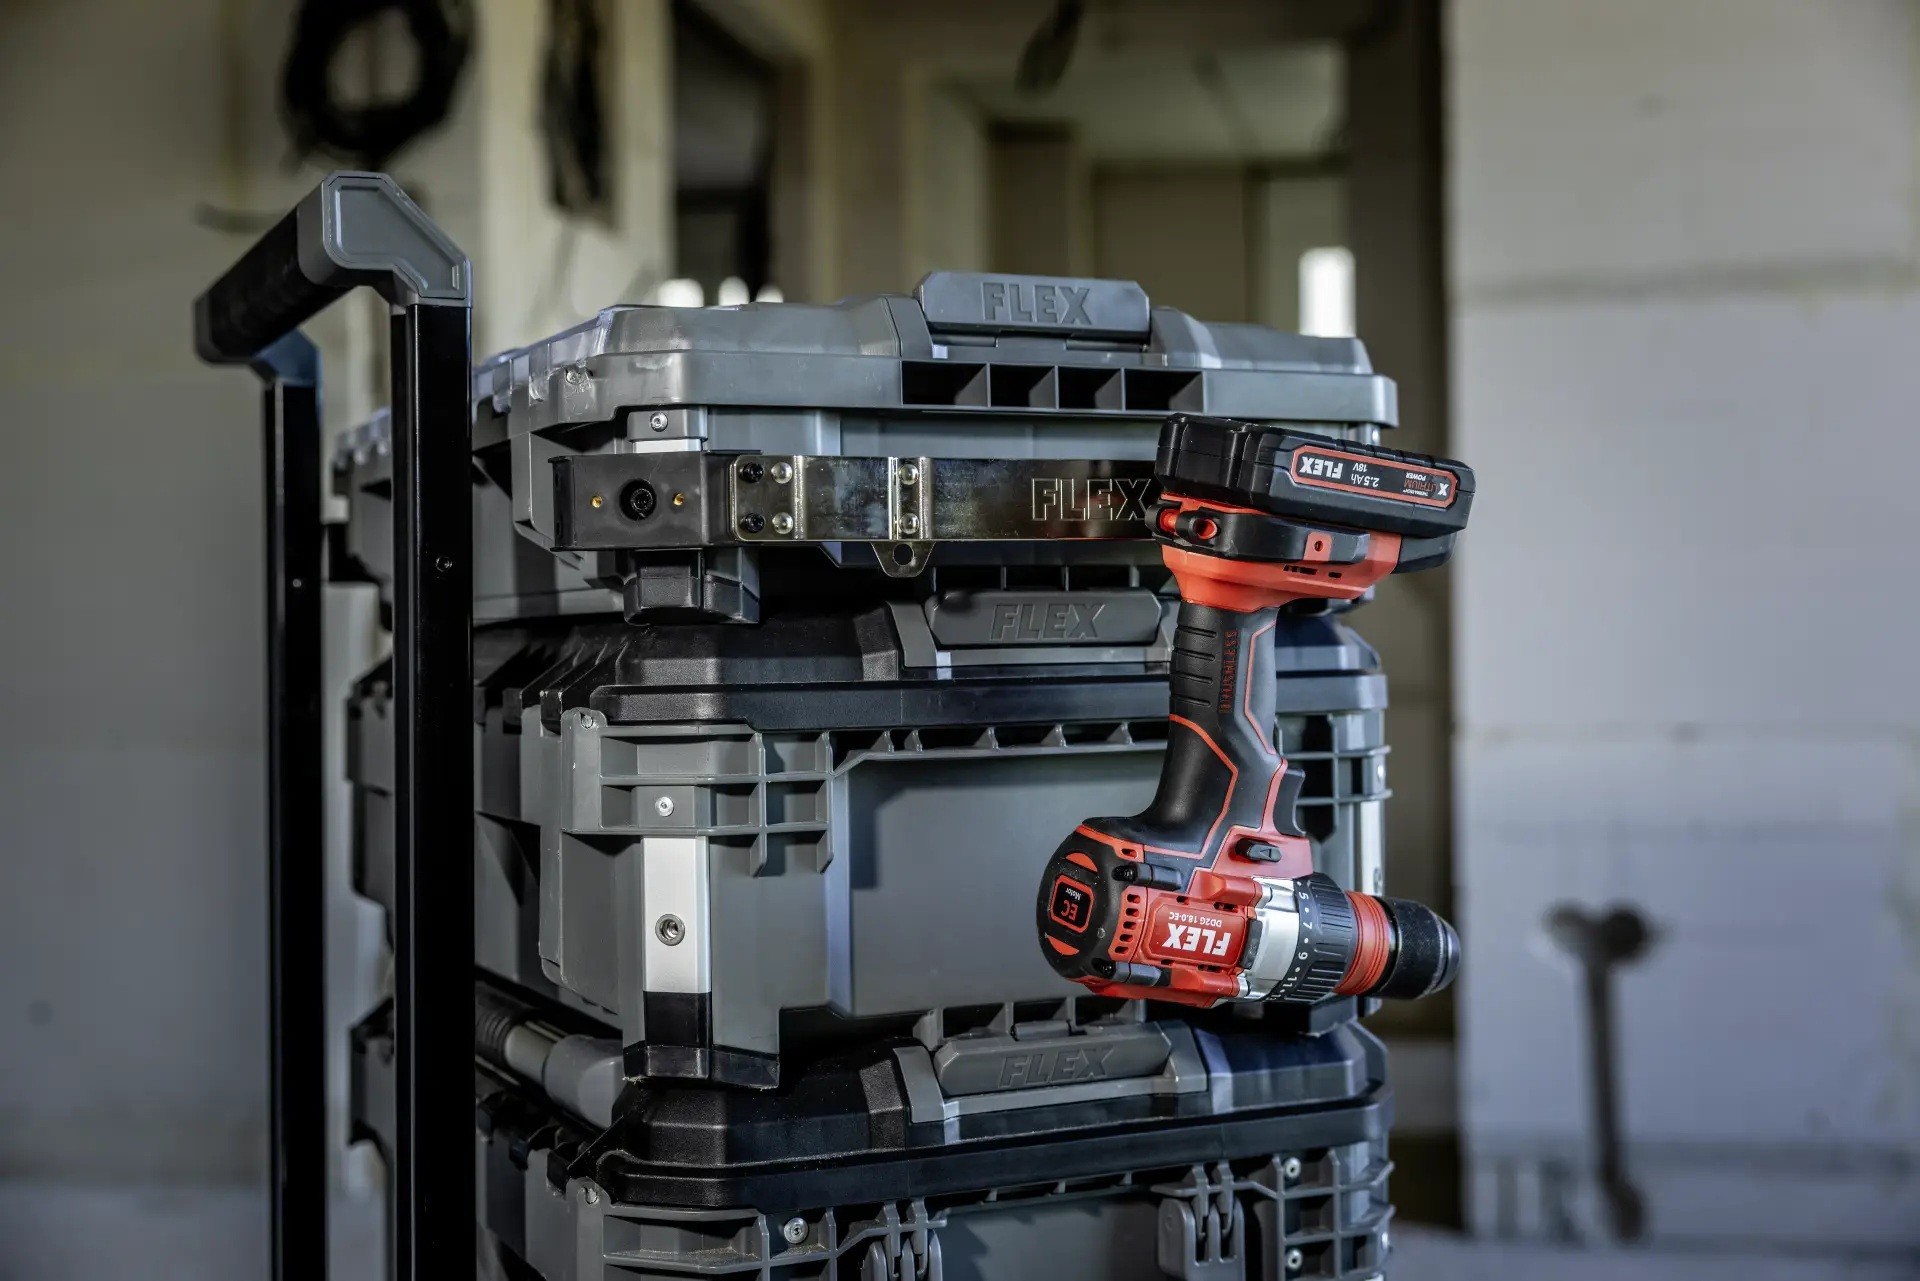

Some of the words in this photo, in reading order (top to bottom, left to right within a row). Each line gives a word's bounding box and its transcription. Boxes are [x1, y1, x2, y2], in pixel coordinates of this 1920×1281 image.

[981, 281, 1092, 325] FLEX
[1299, 456, 1344, 479] FLEX
[1352, 462, 1368, 473] 18V
[1405, 471, 1427, 482] POWER
[1031, 478, 1152, 521] FLEX
[990, 603, 1106, 641] FLEX
[1065, 887, 1082, 901] Motor
[1298, 891, 1309, 900] 5
[1062, 899, 1079, 921] EC
[1168, 911, 1198, 924] 18.0-EC
[1199, 916, 1222, 928] DD2G
[1302, 921, 1313, 930] 7
[1161, 922, 1232, 956] FLEX
[1298, 951, 1308, 960] 9
[1282, 976, 1298, 988] 11
[998, 1047, 1114, 1089] FLEX
